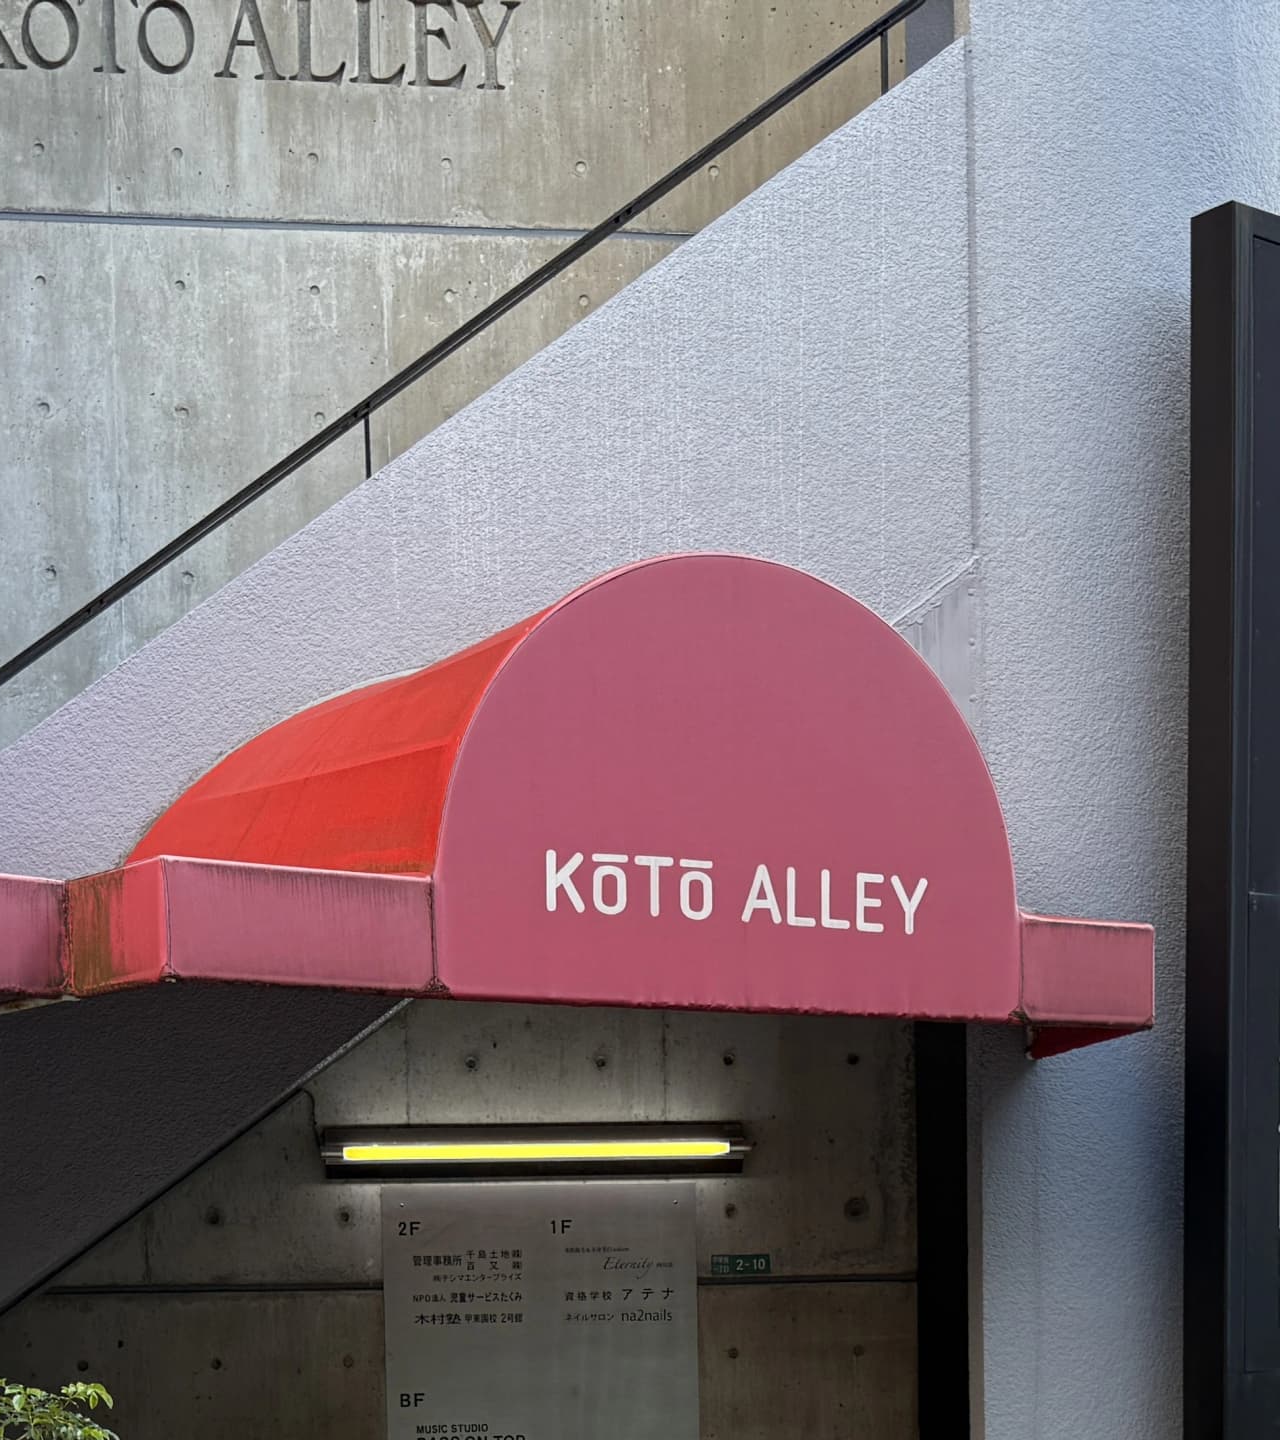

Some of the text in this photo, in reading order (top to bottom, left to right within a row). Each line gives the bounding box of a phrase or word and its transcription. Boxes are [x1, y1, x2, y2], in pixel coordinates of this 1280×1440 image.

[214, 0, 521, 91] ALLEY
[741, 864, 929, 935] ALLEY
[398, 1221, 421, 1237] 2F
[550, 1219, 573, 1235] 1F
[413, 1255, 462, 1267] 管理事務所
[602, 1255, 654, 1280] Eternity
[735, 1257, 766, 1271] 2-10
[413, 1292, 523, 1304] NPO法人 児童サービスたくみ
[565, 1287, 675, 1302] 資格学校 アテナ
[415, 1313, 462, 1325] 木村塾
[565, 1308, 673, 1322] ネイルサロン na2nails
[399, 1392, 426, 1408] BF
[416, 1423, 489, 1435] MUSIC STUDIO
